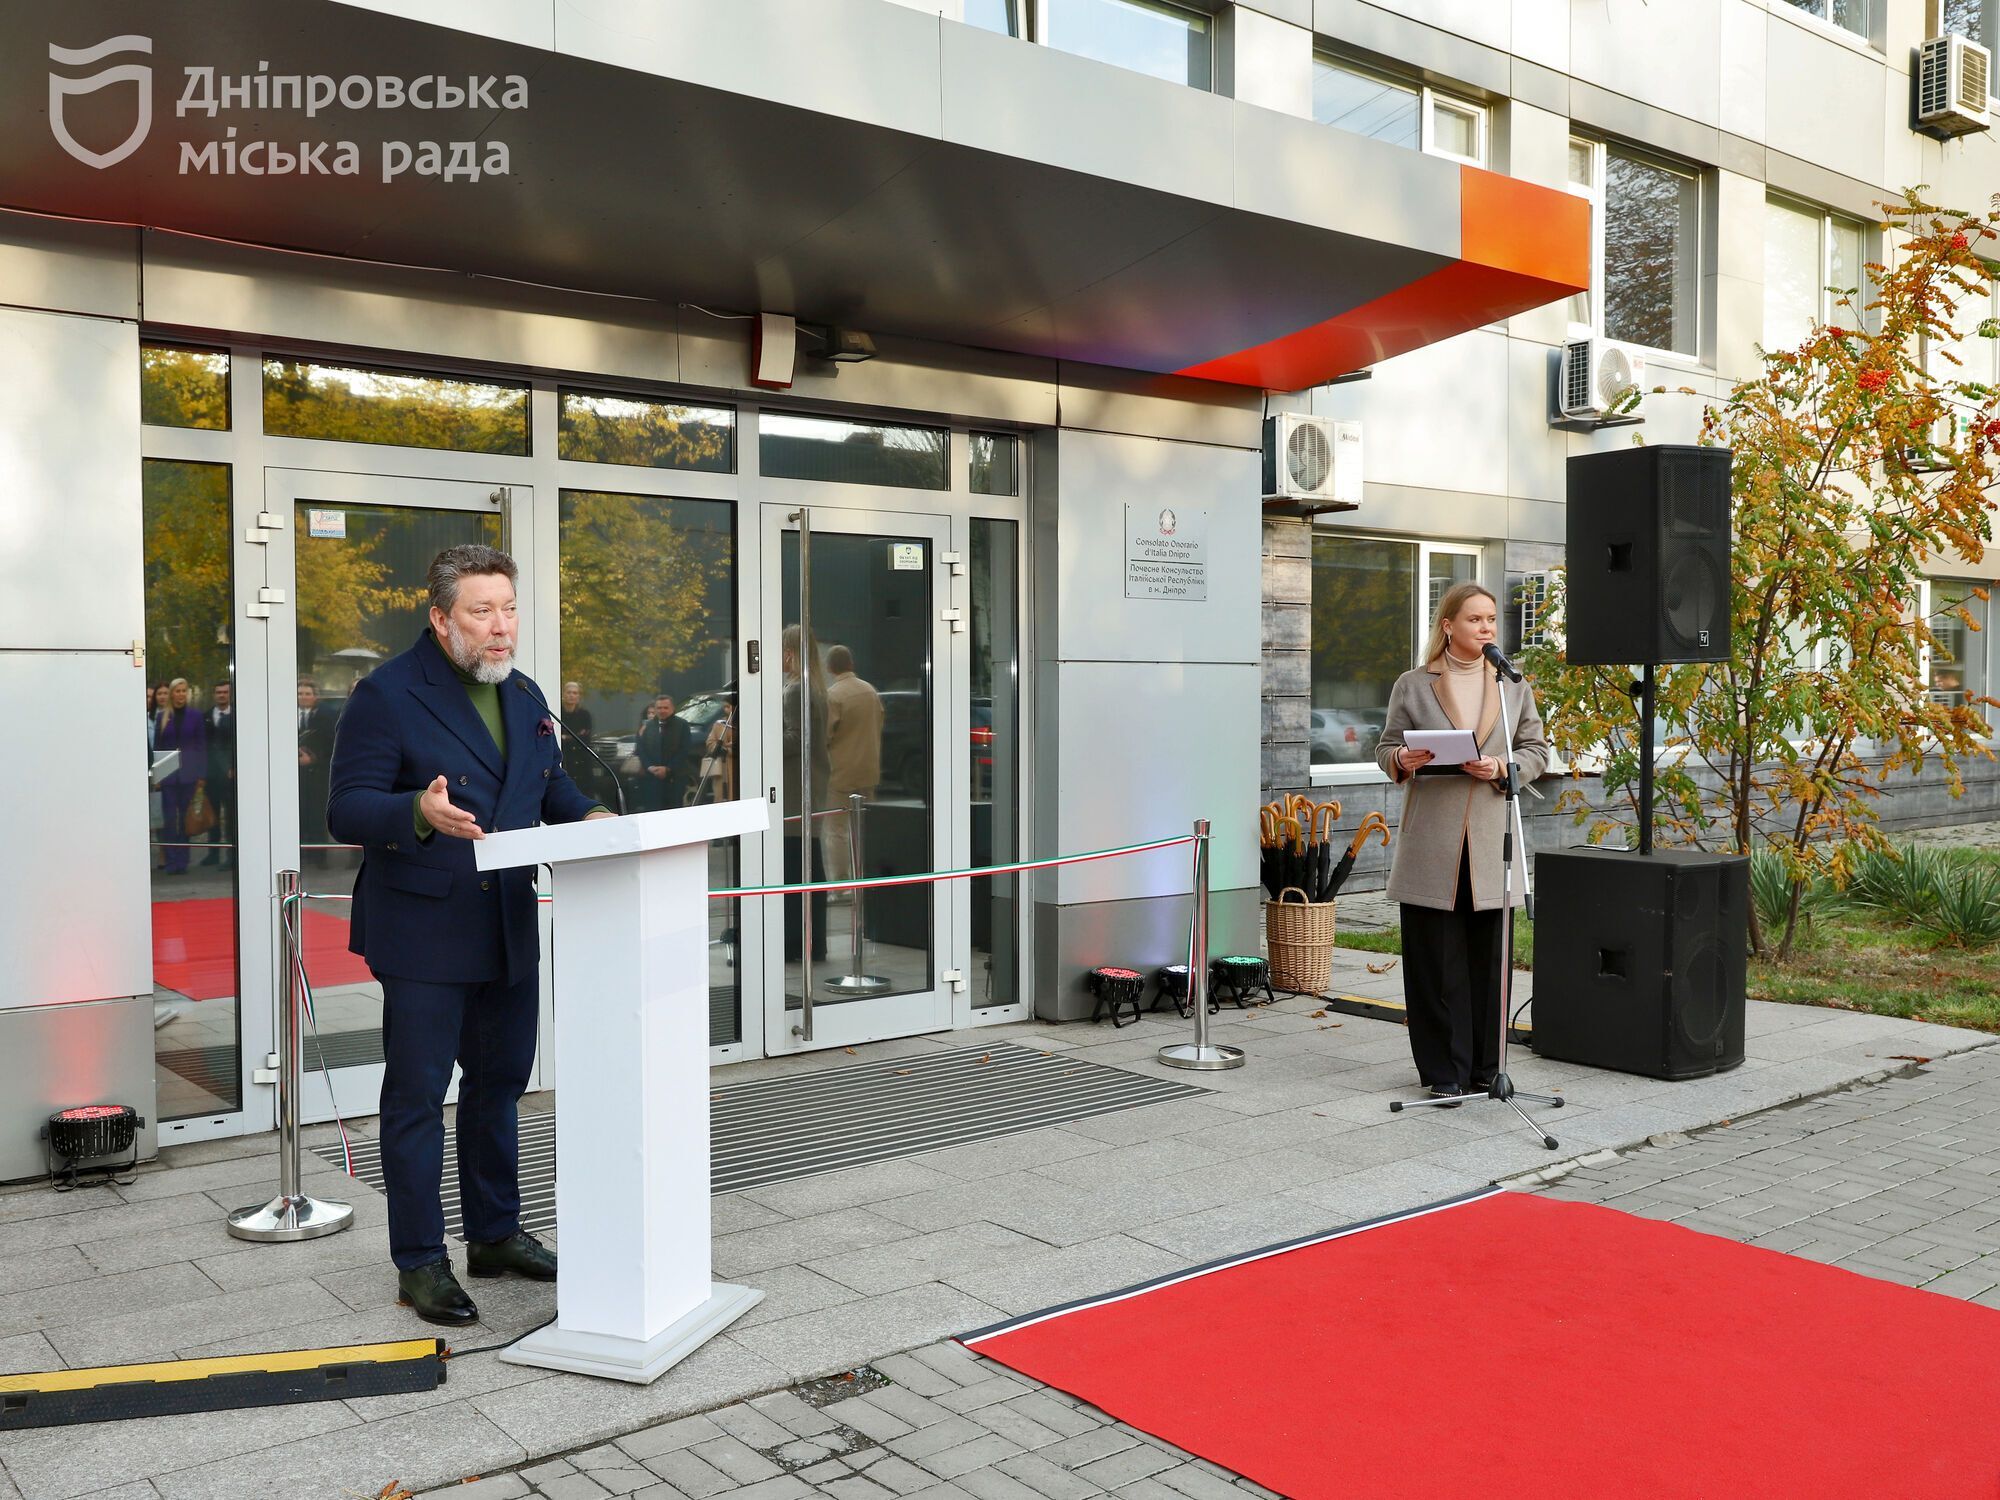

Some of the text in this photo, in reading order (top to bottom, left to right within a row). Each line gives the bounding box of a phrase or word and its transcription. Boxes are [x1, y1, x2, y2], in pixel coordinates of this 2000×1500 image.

[1135, 537, 1198, 549] Consolato Onorario
[1144, 548, 1190, 559] d'Italia Dnipro
[1130, 564, 1204, 576] Почесне Консульство
[1129, 574, 1205, 586] Італійської Республіки
[1163, 585, 1187, 595] Дніпро
